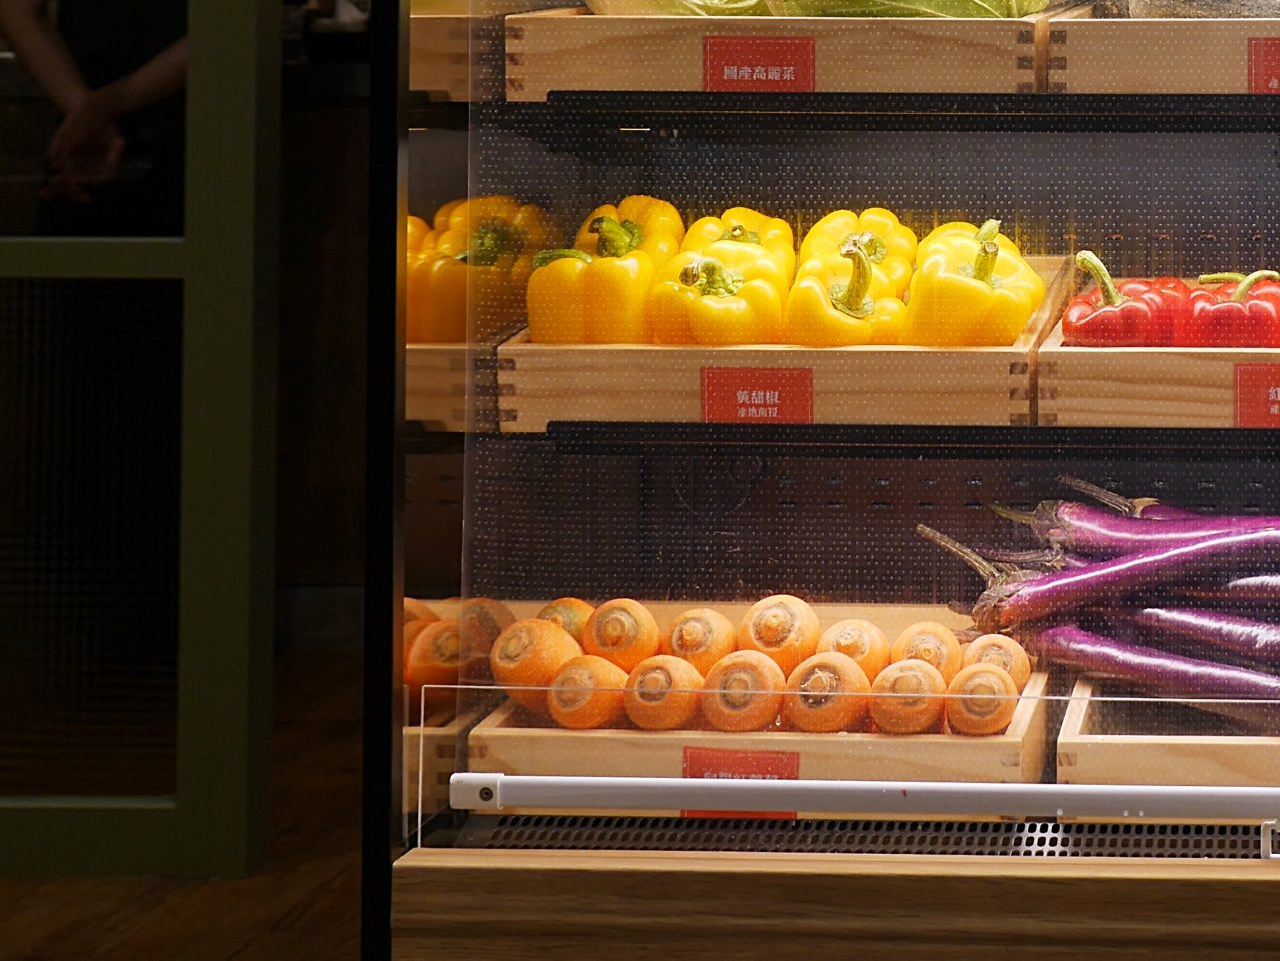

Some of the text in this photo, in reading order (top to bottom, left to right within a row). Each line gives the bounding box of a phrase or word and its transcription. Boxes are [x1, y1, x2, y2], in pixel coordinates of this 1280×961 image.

[723, 65, 796, 81] 國產高麗菜
